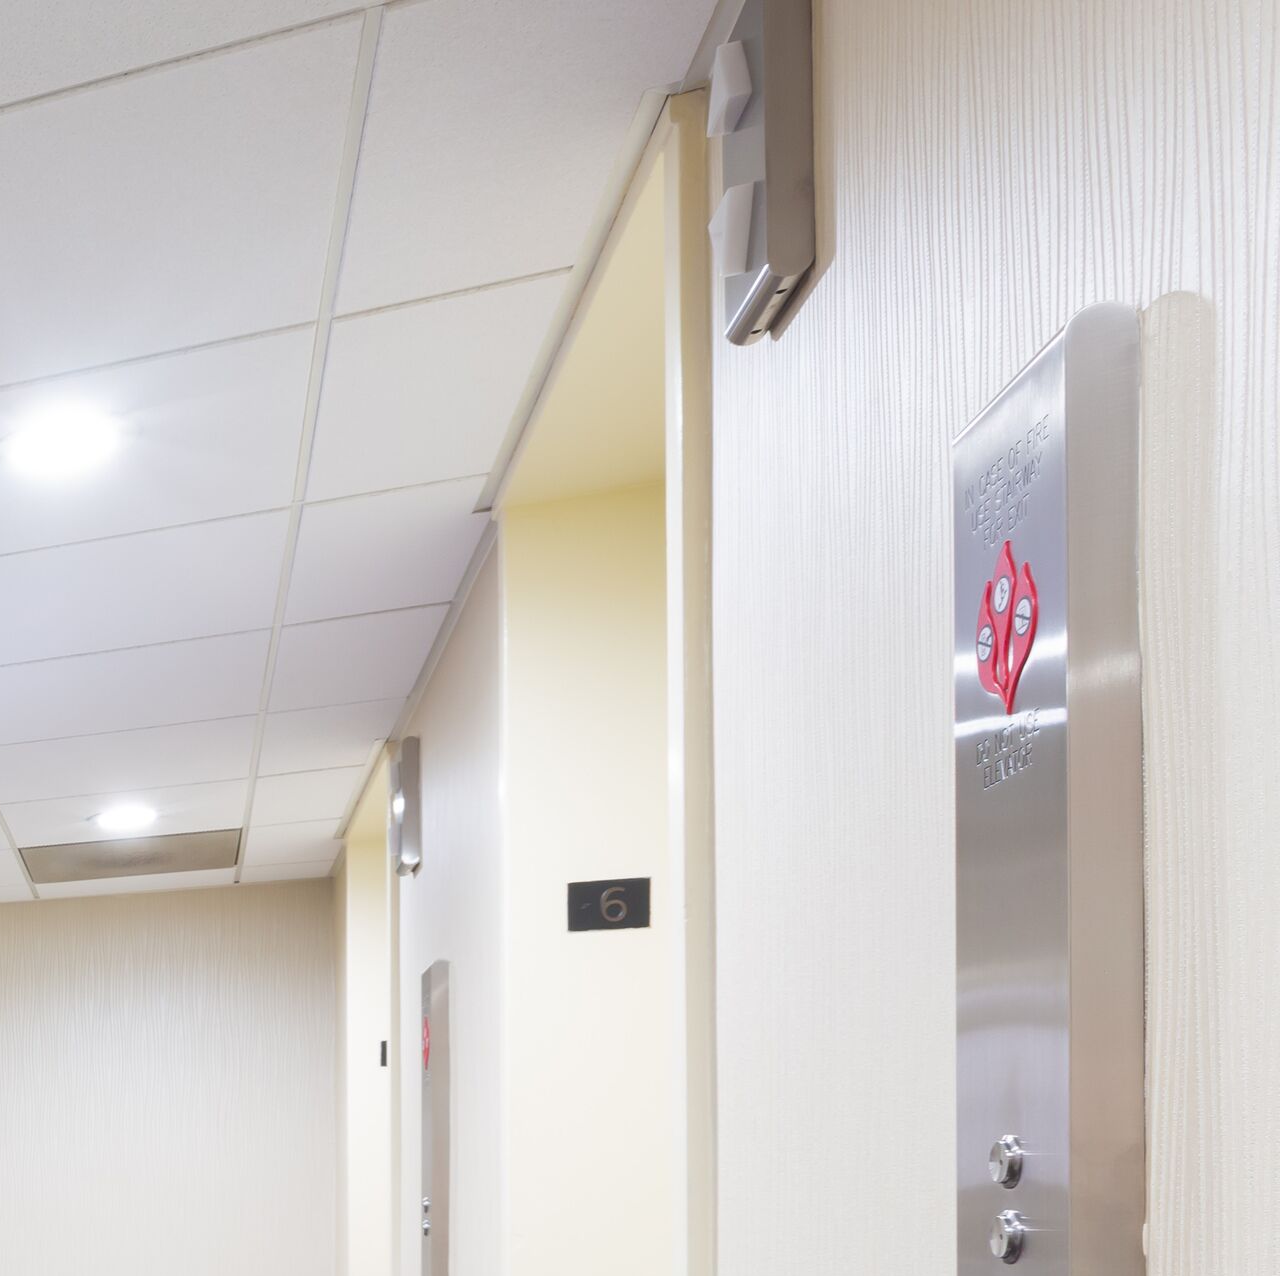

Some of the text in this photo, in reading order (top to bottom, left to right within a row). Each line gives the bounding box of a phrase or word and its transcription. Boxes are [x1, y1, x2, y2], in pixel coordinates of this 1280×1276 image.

[965, 413, 1050, 512] IN CASE OF FIRE
[971, 450, 1043, 535] USE STAIRWAY
[983, 492, 1031, 551] FOR EXIT
[976, 707, 1041, 767] DO NOT USE
[983, 742, 1033, 791] ELEVATOR
[600, 886, 628, 922] 6
